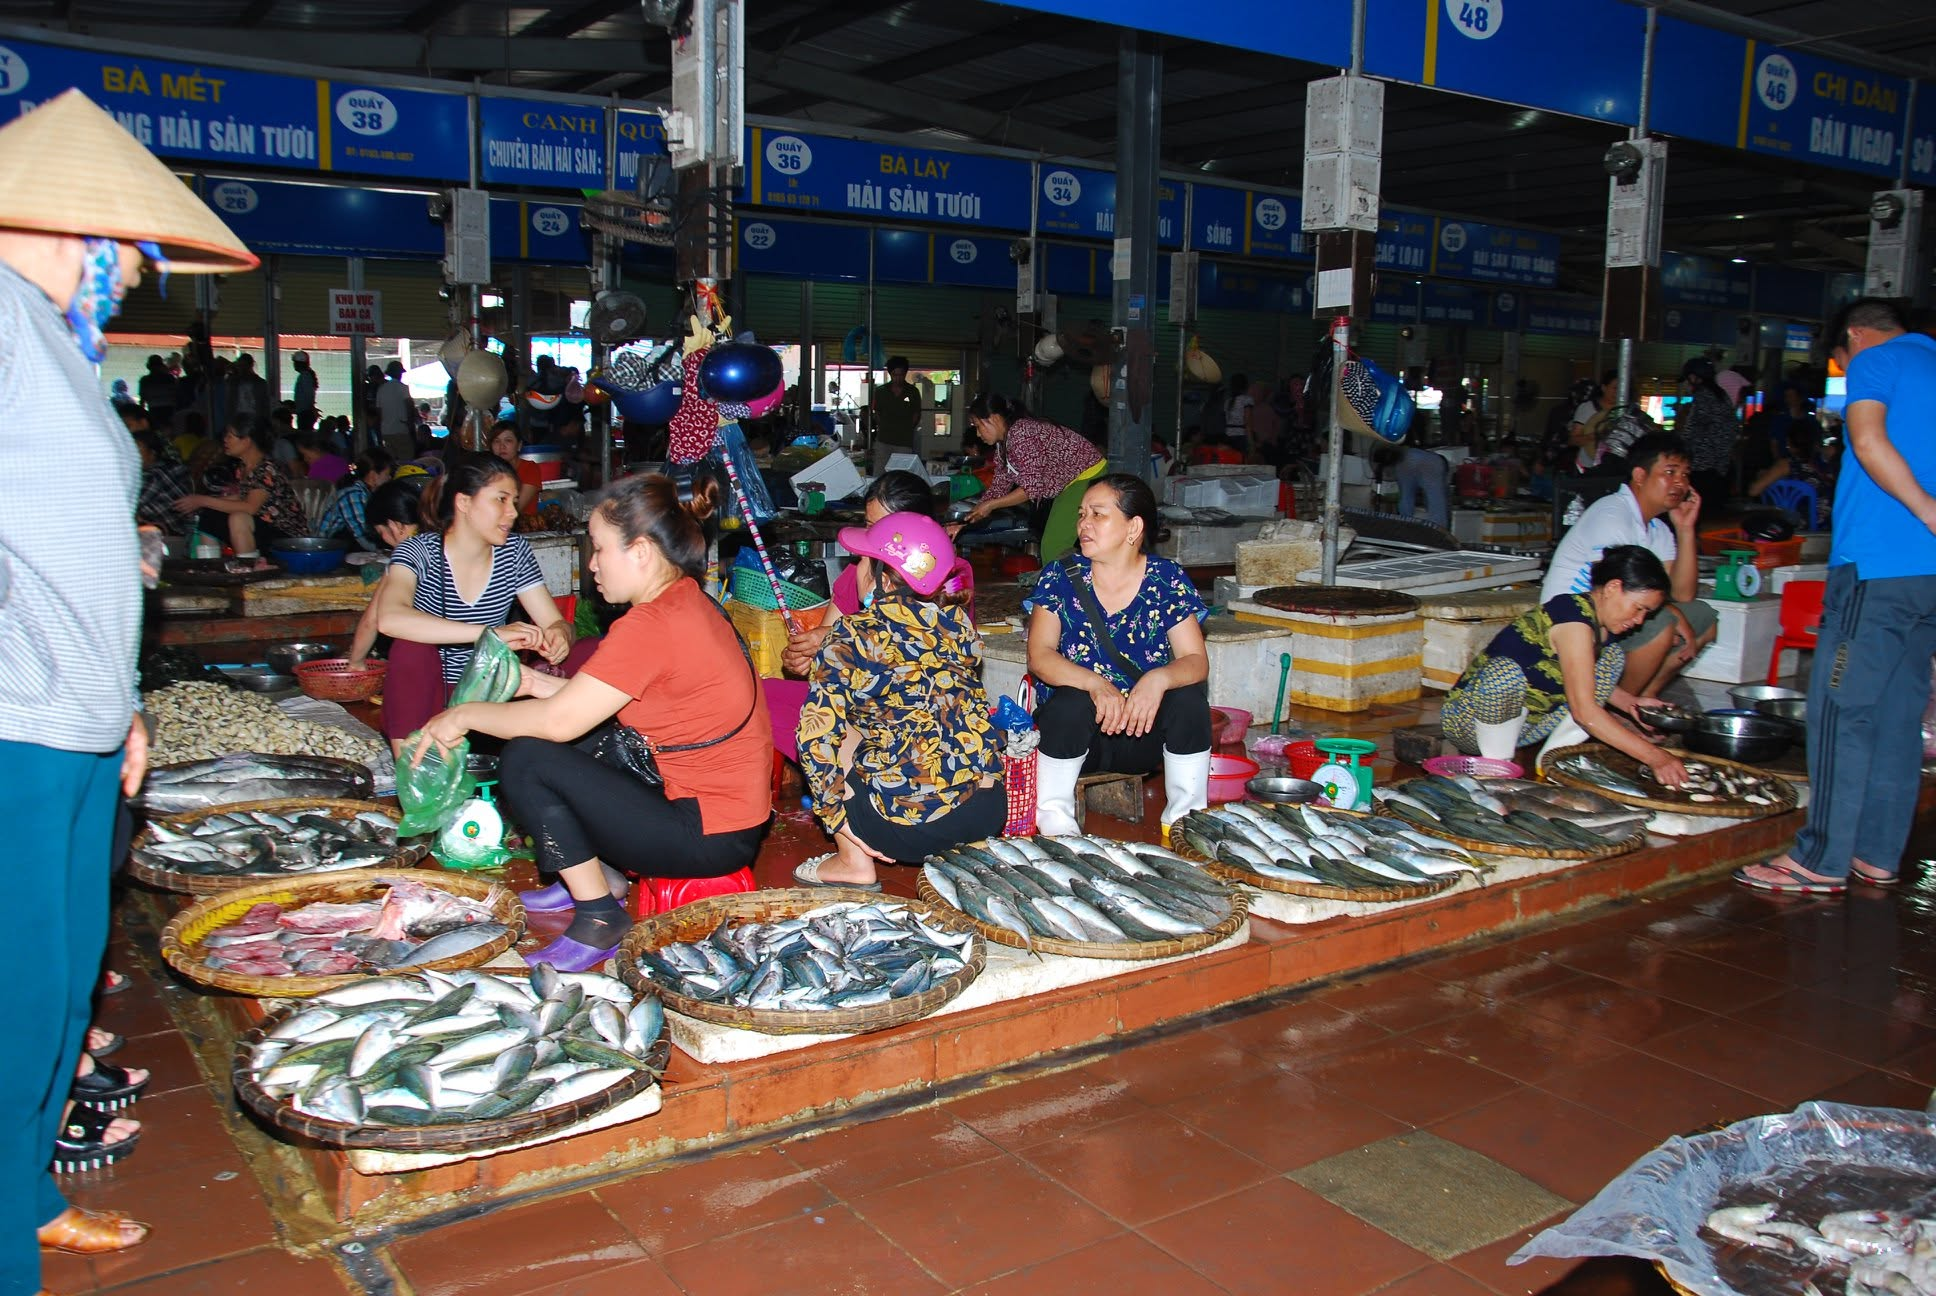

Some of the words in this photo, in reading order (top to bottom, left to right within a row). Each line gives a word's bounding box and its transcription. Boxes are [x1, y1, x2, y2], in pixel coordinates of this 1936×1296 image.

[1459, 3, 1489, 33] 48
[1766, 80, 1786, 104] 46
[351, 111, 383, 131] 38
[522, 112, 597, 135] CANH
[160, 110, 200, 150] HẢI
[208, 115, 256, 155] SẢN
[261, 123, 315, 160] TƯƠI
[1808, 114, 1847, 157] BÁN
[1848, 124, 1894, 167] NGAO
[489, 137, 530, 170] CHUYÊN
[531, 139, 553, 172] BÁN
[554, 137, 572, 173] HẢI
[778, 154, 801, 170] 36
[225, 197, 247, 209] 26
[847, 179, 882, 211] HẢI
[889, 183, 929, 215] SẢN
[935, 192, 981, 220] TƯƠI
[1053, 187, 1072, 202] 34
[541, 221, 561, 233] 24
[1262, 213, 1279, 227] 32
[752, 235, 769, 247] 22
[956, 250, 972, 261] 20
[335, 293, 353, 306] KHU
